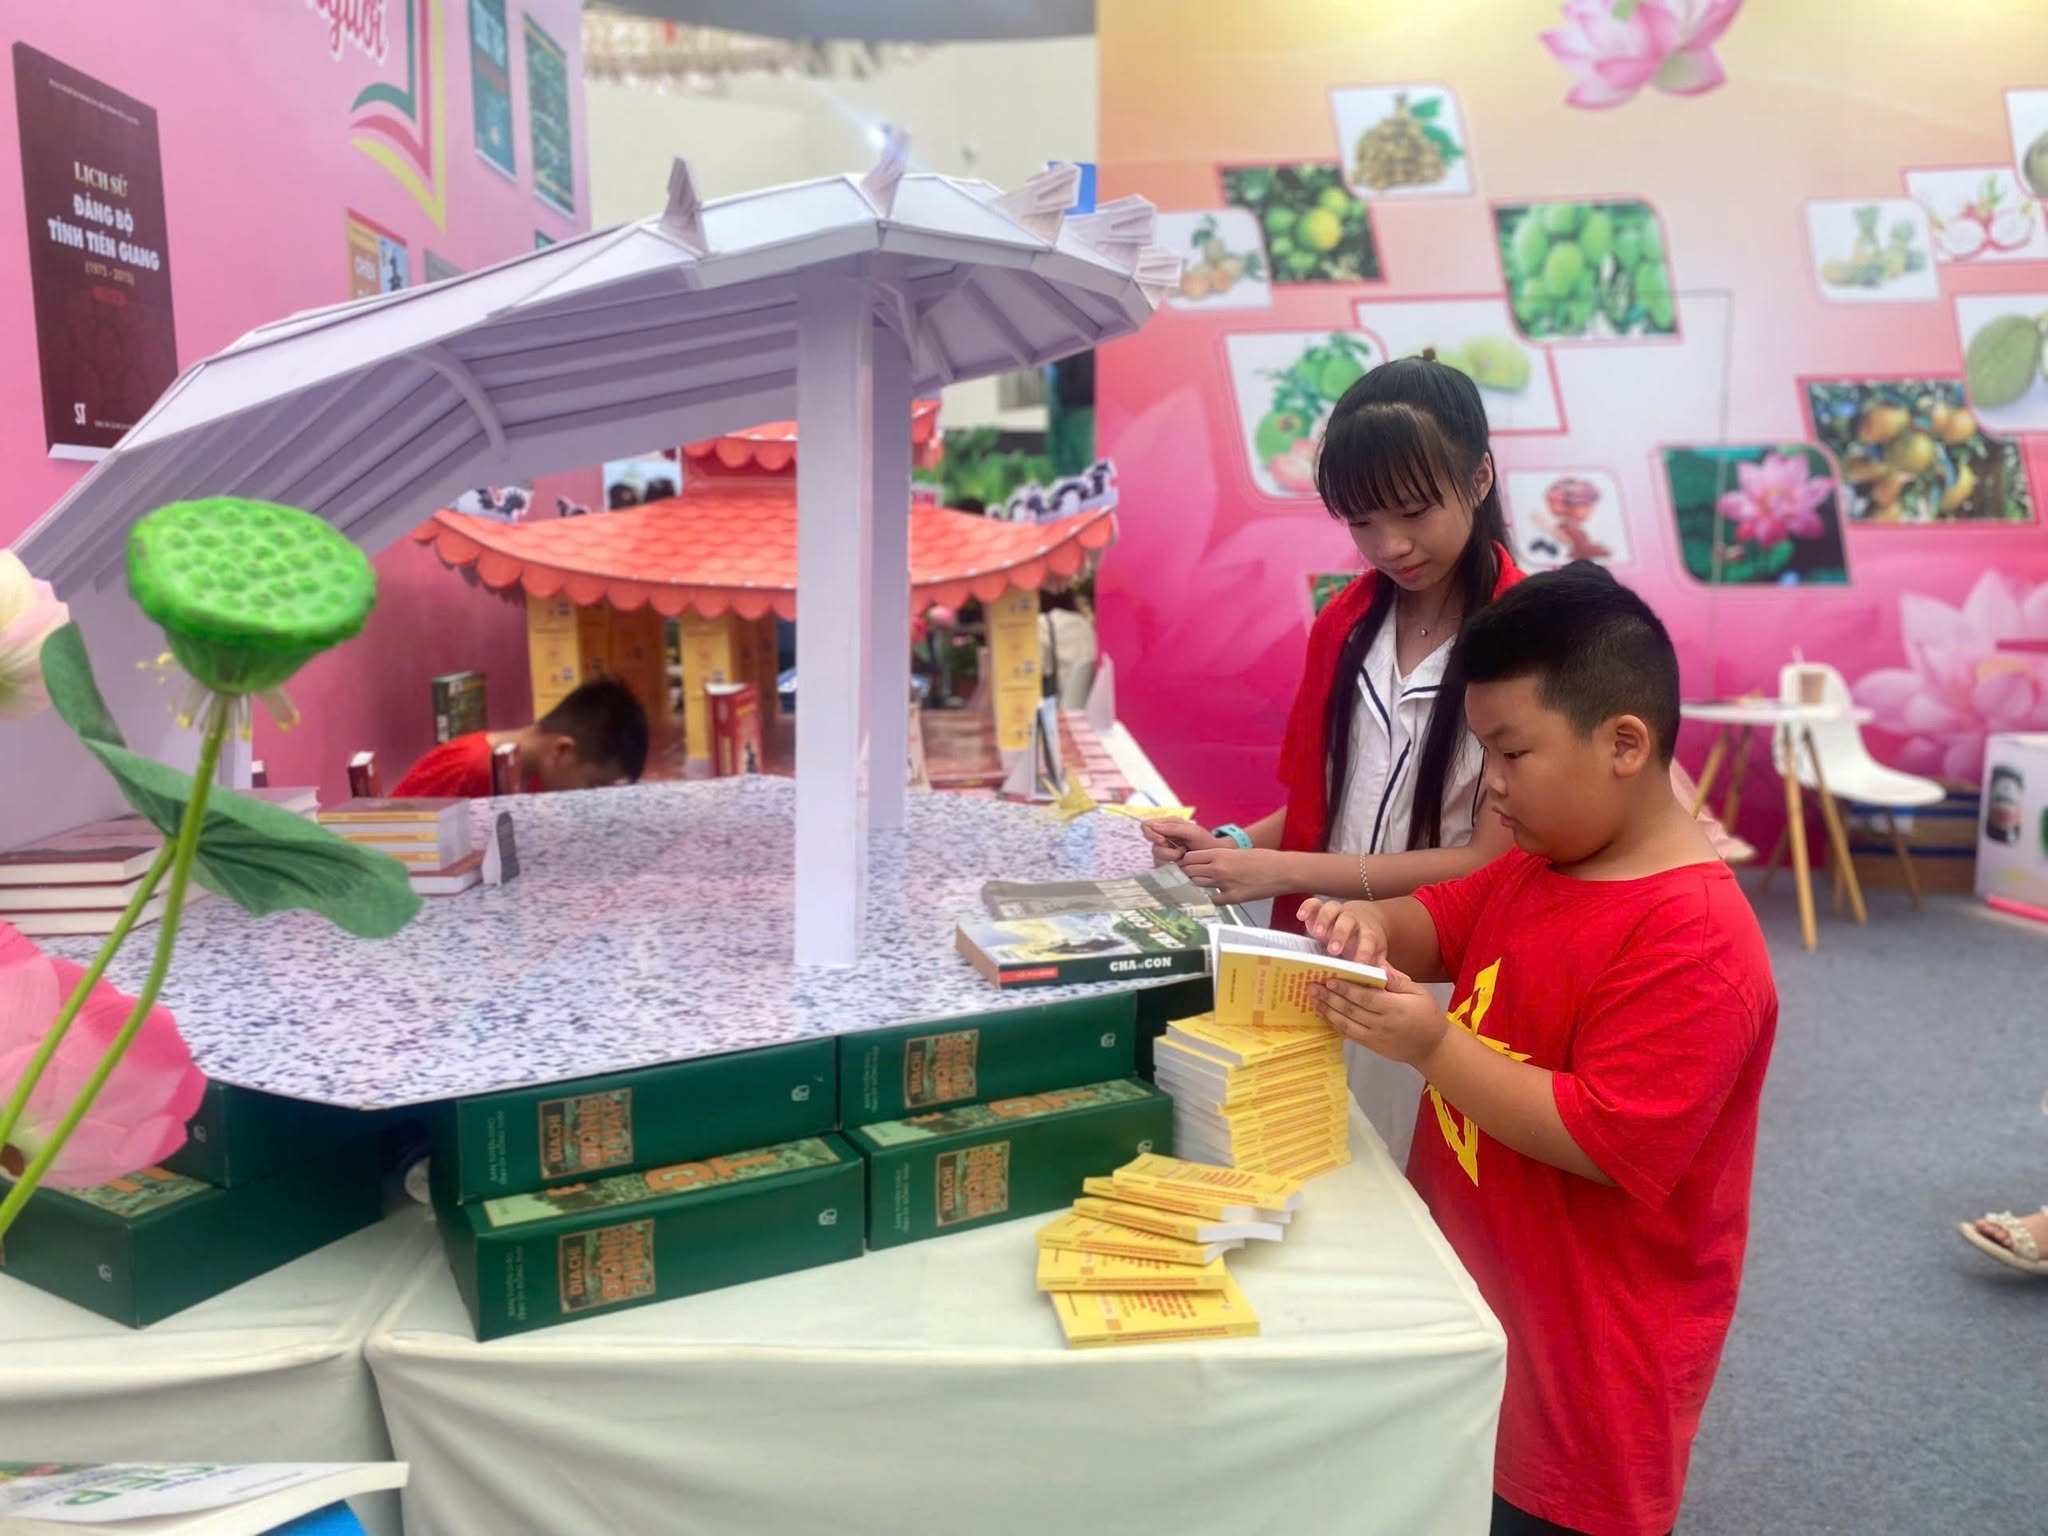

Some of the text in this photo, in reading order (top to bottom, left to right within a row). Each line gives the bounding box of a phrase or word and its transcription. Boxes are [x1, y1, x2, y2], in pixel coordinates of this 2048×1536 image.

[118, 241, 160, 272] GIANG
[1109, 959, 1137, 972] CHA
[1144, 956, 1172, 969] CON
